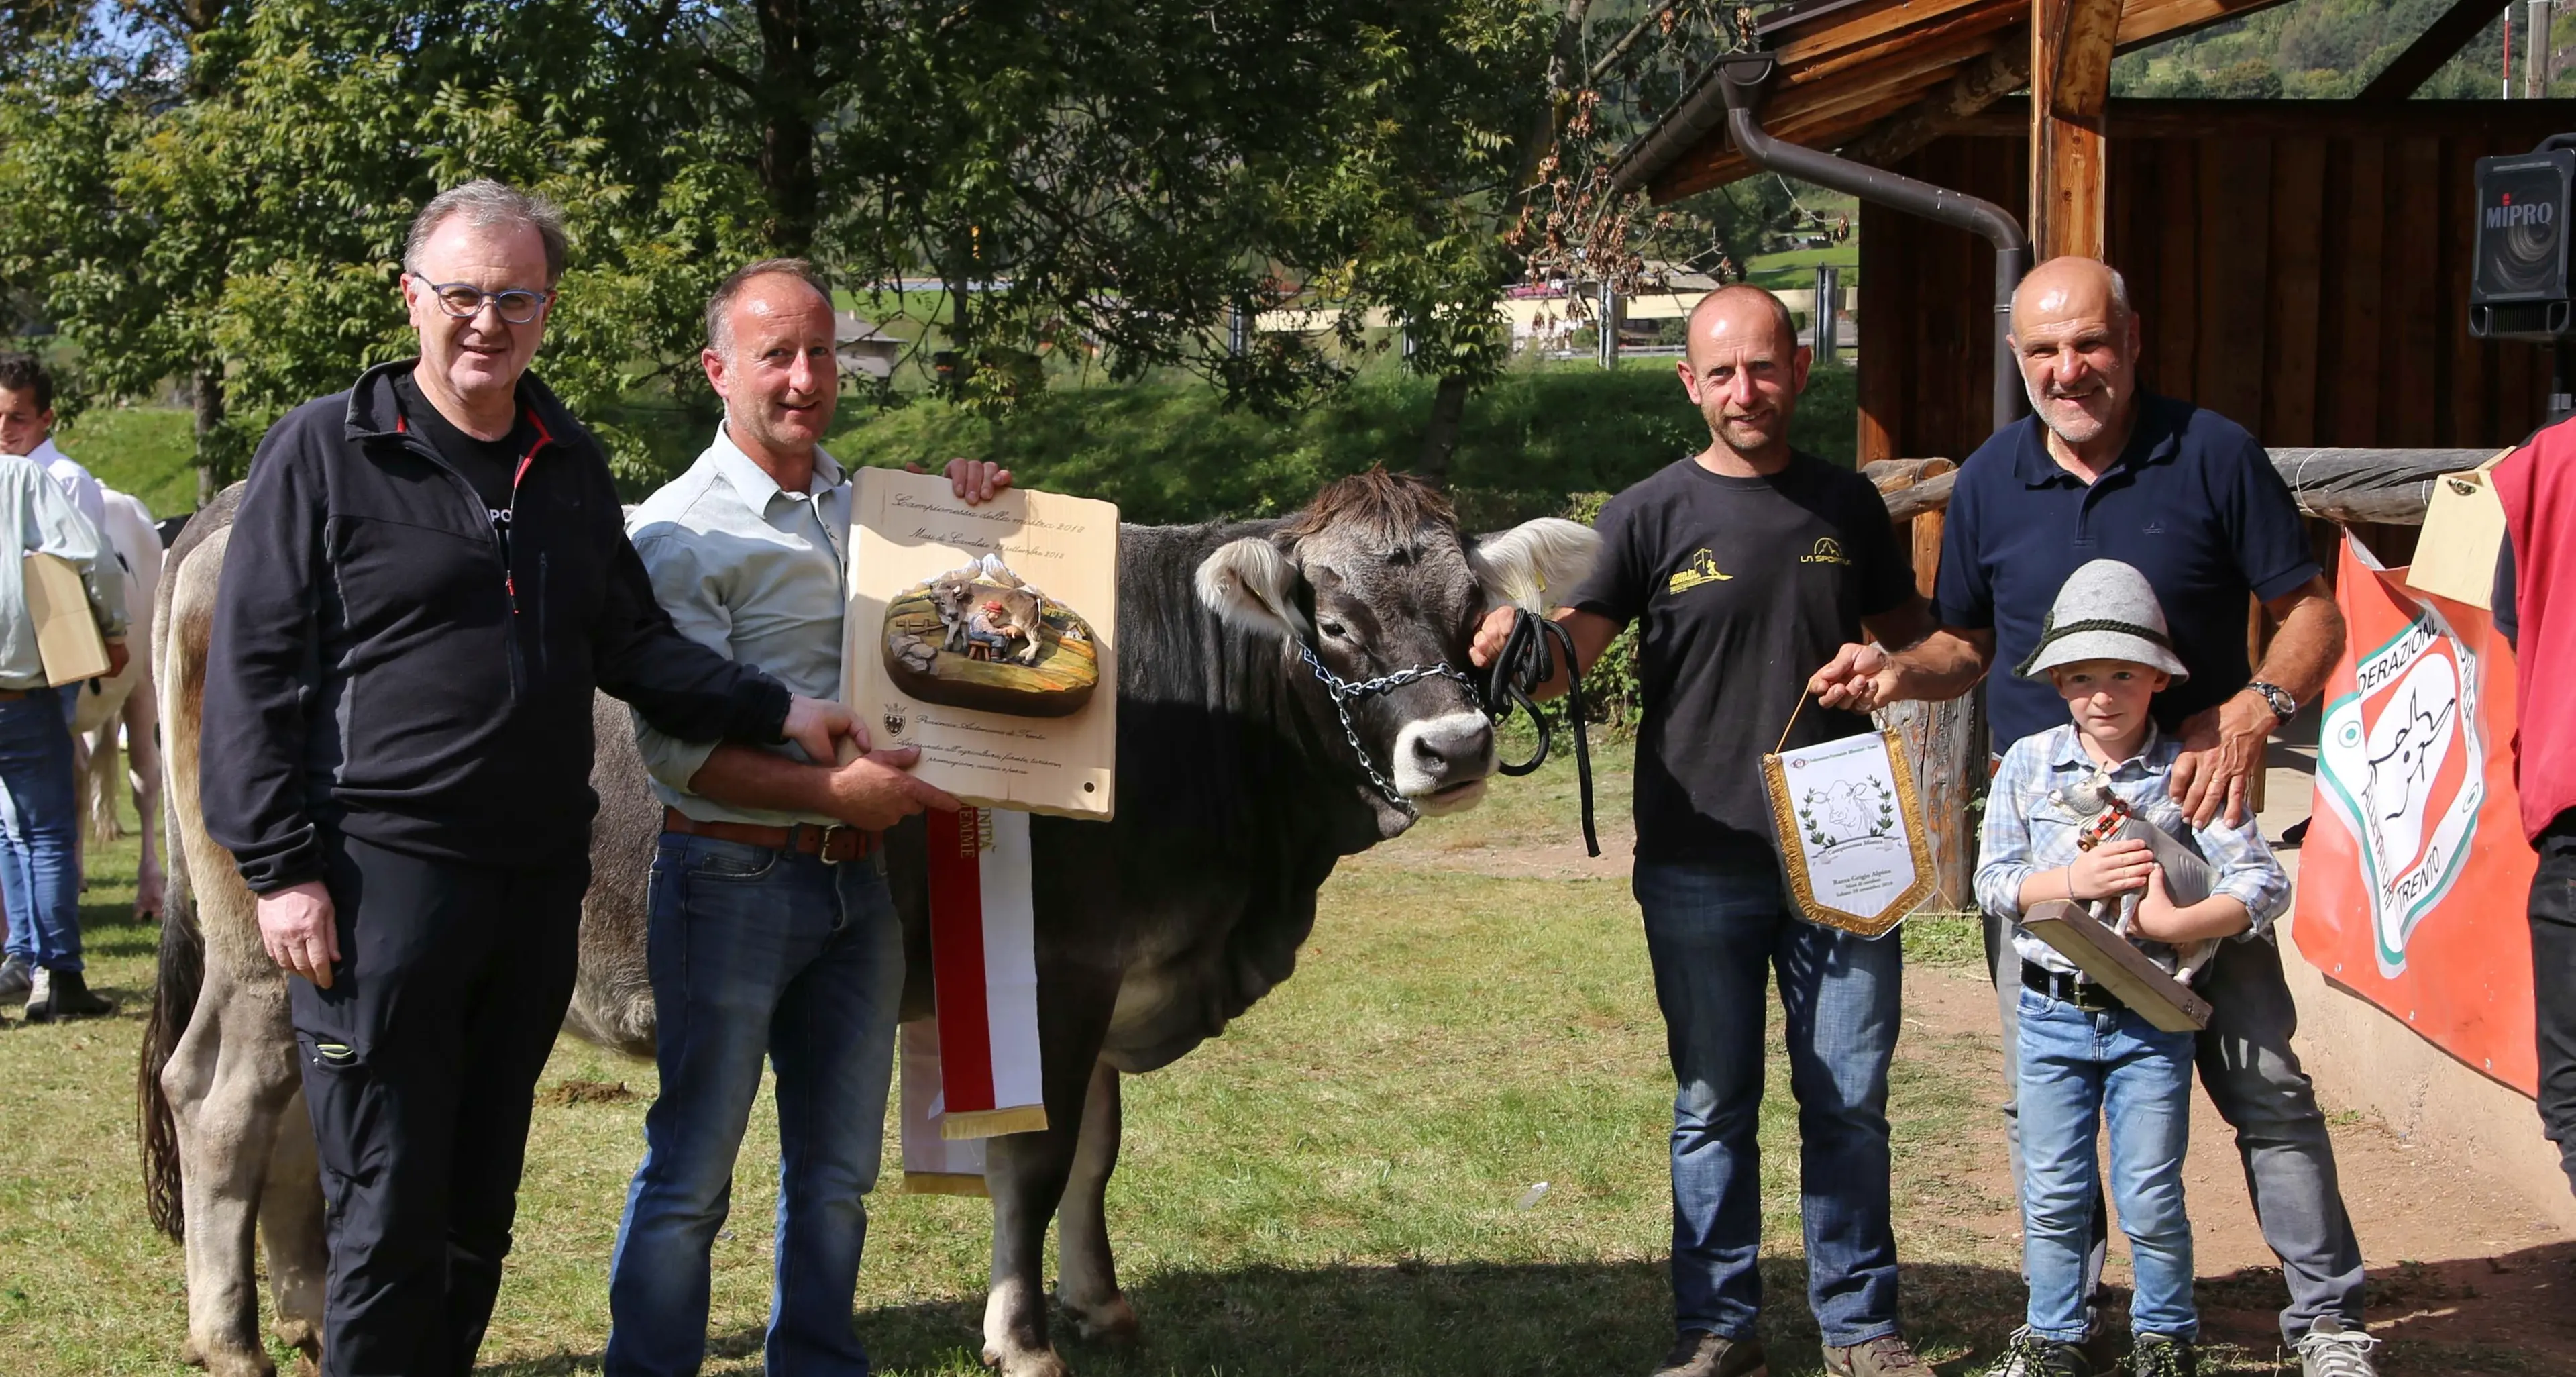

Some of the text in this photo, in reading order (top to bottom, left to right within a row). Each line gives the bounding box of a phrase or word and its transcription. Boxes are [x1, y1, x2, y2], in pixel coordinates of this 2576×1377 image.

[891, 493, 1085, 533] Campionessa della mostra 2018
[1800, 555, 1814, 563] LA
[977, 807, 997, 854] NITÀ
[2397, 846, 2440, 913] TRENTO
